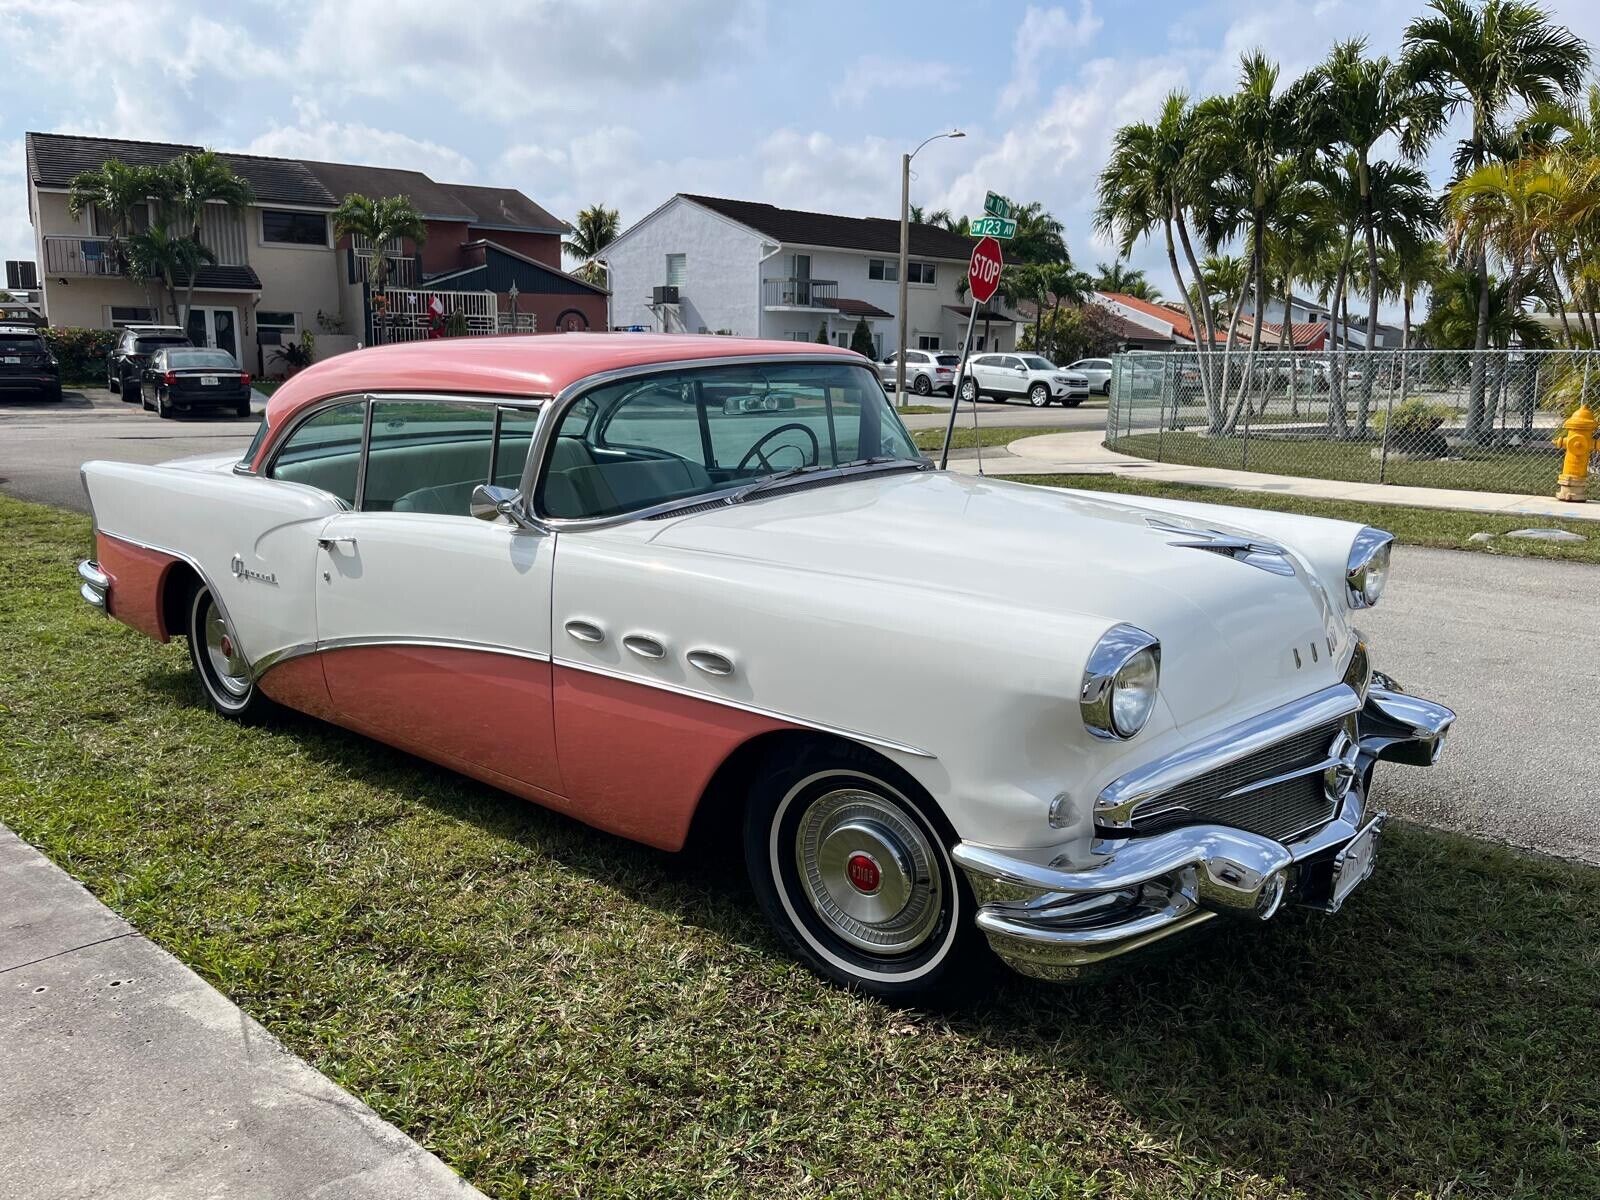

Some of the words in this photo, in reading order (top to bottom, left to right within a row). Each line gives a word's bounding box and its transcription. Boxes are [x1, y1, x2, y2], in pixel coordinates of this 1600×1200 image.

[995, 199, 1004, 215] 10
[971, 222, 981, 233] SW
[982, 220, 1001, 235] 123
[1004, 225, 1014, 235] AV
[971, 253, 1000, 284] STOP
